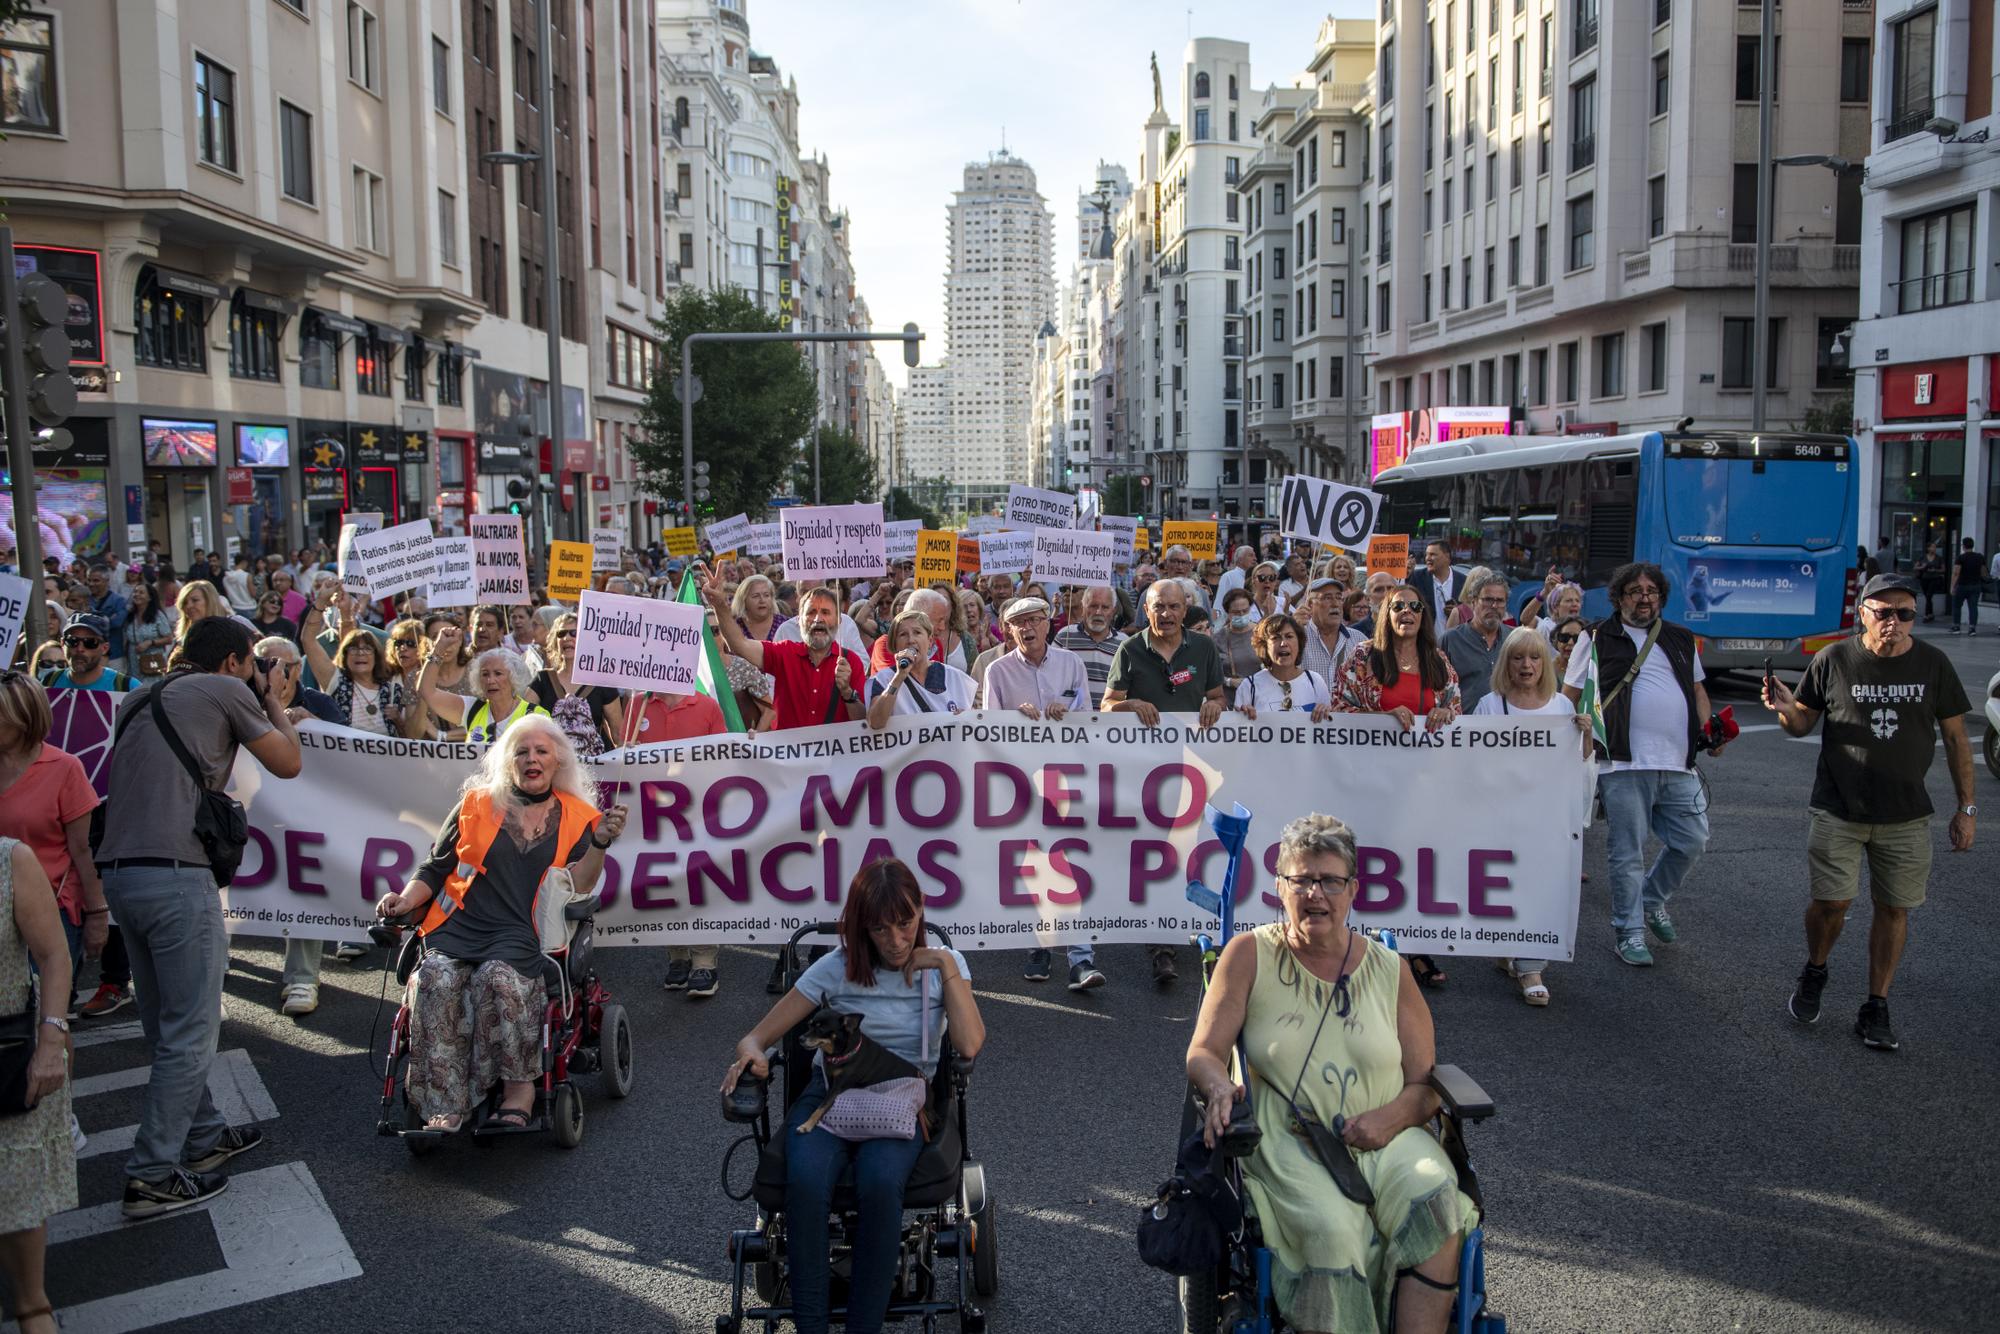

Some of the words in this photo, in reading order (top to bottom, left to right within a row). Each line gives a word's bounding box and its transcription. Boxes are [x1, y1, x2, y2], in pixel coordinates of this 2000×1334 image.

[1750, 436, 1760, 455] 1
[1795, 445, 1821, 456] 5640
[1012, 496, 1038, 509] ¡OTRO
[1040, 500, 1057, 512] TIPO
[1059, 505, 1070, 516] DE
[1011, 511, 1066, 529] RESIDENCIAS!
[473, 525, 518, 540] MALTRATAR
[785, 519, 832, 546] Dignidad
[834, 525, 842, 544] y
[844, 523, 882, 542] respeto
[1189, 531, 1204, 540] TIPO
[1205, 531, 1215, 540] DE
[1678, 535, 1723, 543] CITARO
[361, 545, 388, 560] Ratios
[389, 540, 406, 553] más
[408, 534, 432, 550] justas
[925, 539, 951, 554] ¡MAYOR
[981, 540, 1009, 555] Dignidad
[1037, 537, 1074, 557] Dignidad
[1075, 546, 1081, 559] y
[1081, 546, 1111, 561] respeto
[366, 566, 376, 576] en
[377, 557, 405, 573] servicios
[407, 550, 434, 566] sociales
[476, 552, 487, 566] AL
[489, 552, 521, 570] MAYOR,
[787, 558, 800, 571] en
[803, 553, 818, 570] las
[820, 550, 883, 569] residencias.
[921, 559, 951, 571] RESPETO
[983, 562, 990, 570] en
[992, 558, 1001, 569] las
[405, 570, 412, 580] de
[413, 565, 436, 579] mayores
[1035, 566, 1045, 575] en
[1048, 561, 1059, 575] las
[1061, 562, 1109, 580] residencias.
[479, 576, 523, 596] ¡JAMÁS!
[584, 606, 642, 641] Dignidad
[643, 622, 653, 647] y
[654, 624, 700, 651] respeto
[579, 652, 594, 672] en
[598, 649, 616, 674] las
[619, 653, 694, 684] residencias.
[1851, 684, 1883, 697] CALL
[1888, 684, 1925, 697] DUTY
[324, 735, 348, 753] DE
[353, 737, 478, 760] RESIDÈNCIES
[624, 747, 684, 766] BESTE
[691, 739, 844, 762] ERRESIDENTZIA
[849, 731, 912, 753] EREDU
[918, 725, 956, 744] BAT
[962, 725, 1055, 744] POSIBLEA
[1061, 726, 1089, 743] DA
[1107, 727, 1179, 744] OUTRO
[1186, 726, 1273, 744] MODELO
[1280, 727, 1305, 744] DE
[1313, 728, 1444, 748] RESIDENCIAS
[1451, 724, 1463, 747] É
[1469, 725, 1556, 748] POSÍBEL
[799, 759, 1208, 832] MODELO
[231, 825, 328, 896] DE
[999, 838, 1092, 906] ES
[258, 908, 273, 921] de
[276, 909, 293, 923] los
[297, 911, 350, 926] derechos
[596, 926, 603, 936] y
[607, 921, 663, 936] personas
[666, 921, 688, 932] con
[692, 917, 770, 932] discapacidad
[781, 918, 800, 930] NO
[979, 919, 1033, 935] laborales
[1036, 918, 1050, 931] de
[1054, 917, 1069, 931] las
[1072, 915, 1147, 932] trabajadoras
[1158, 917, 1178, 930] NO
[1181, 920, 1188, 930] a
[1192, 917, 1202, 930] la
[1386, 925, 1437, 940] ervicios
[1441, 926, 1457, 940] de
[1461, 927, 1472, 941] la
[1475, 927, 1559, 945] dependencia
